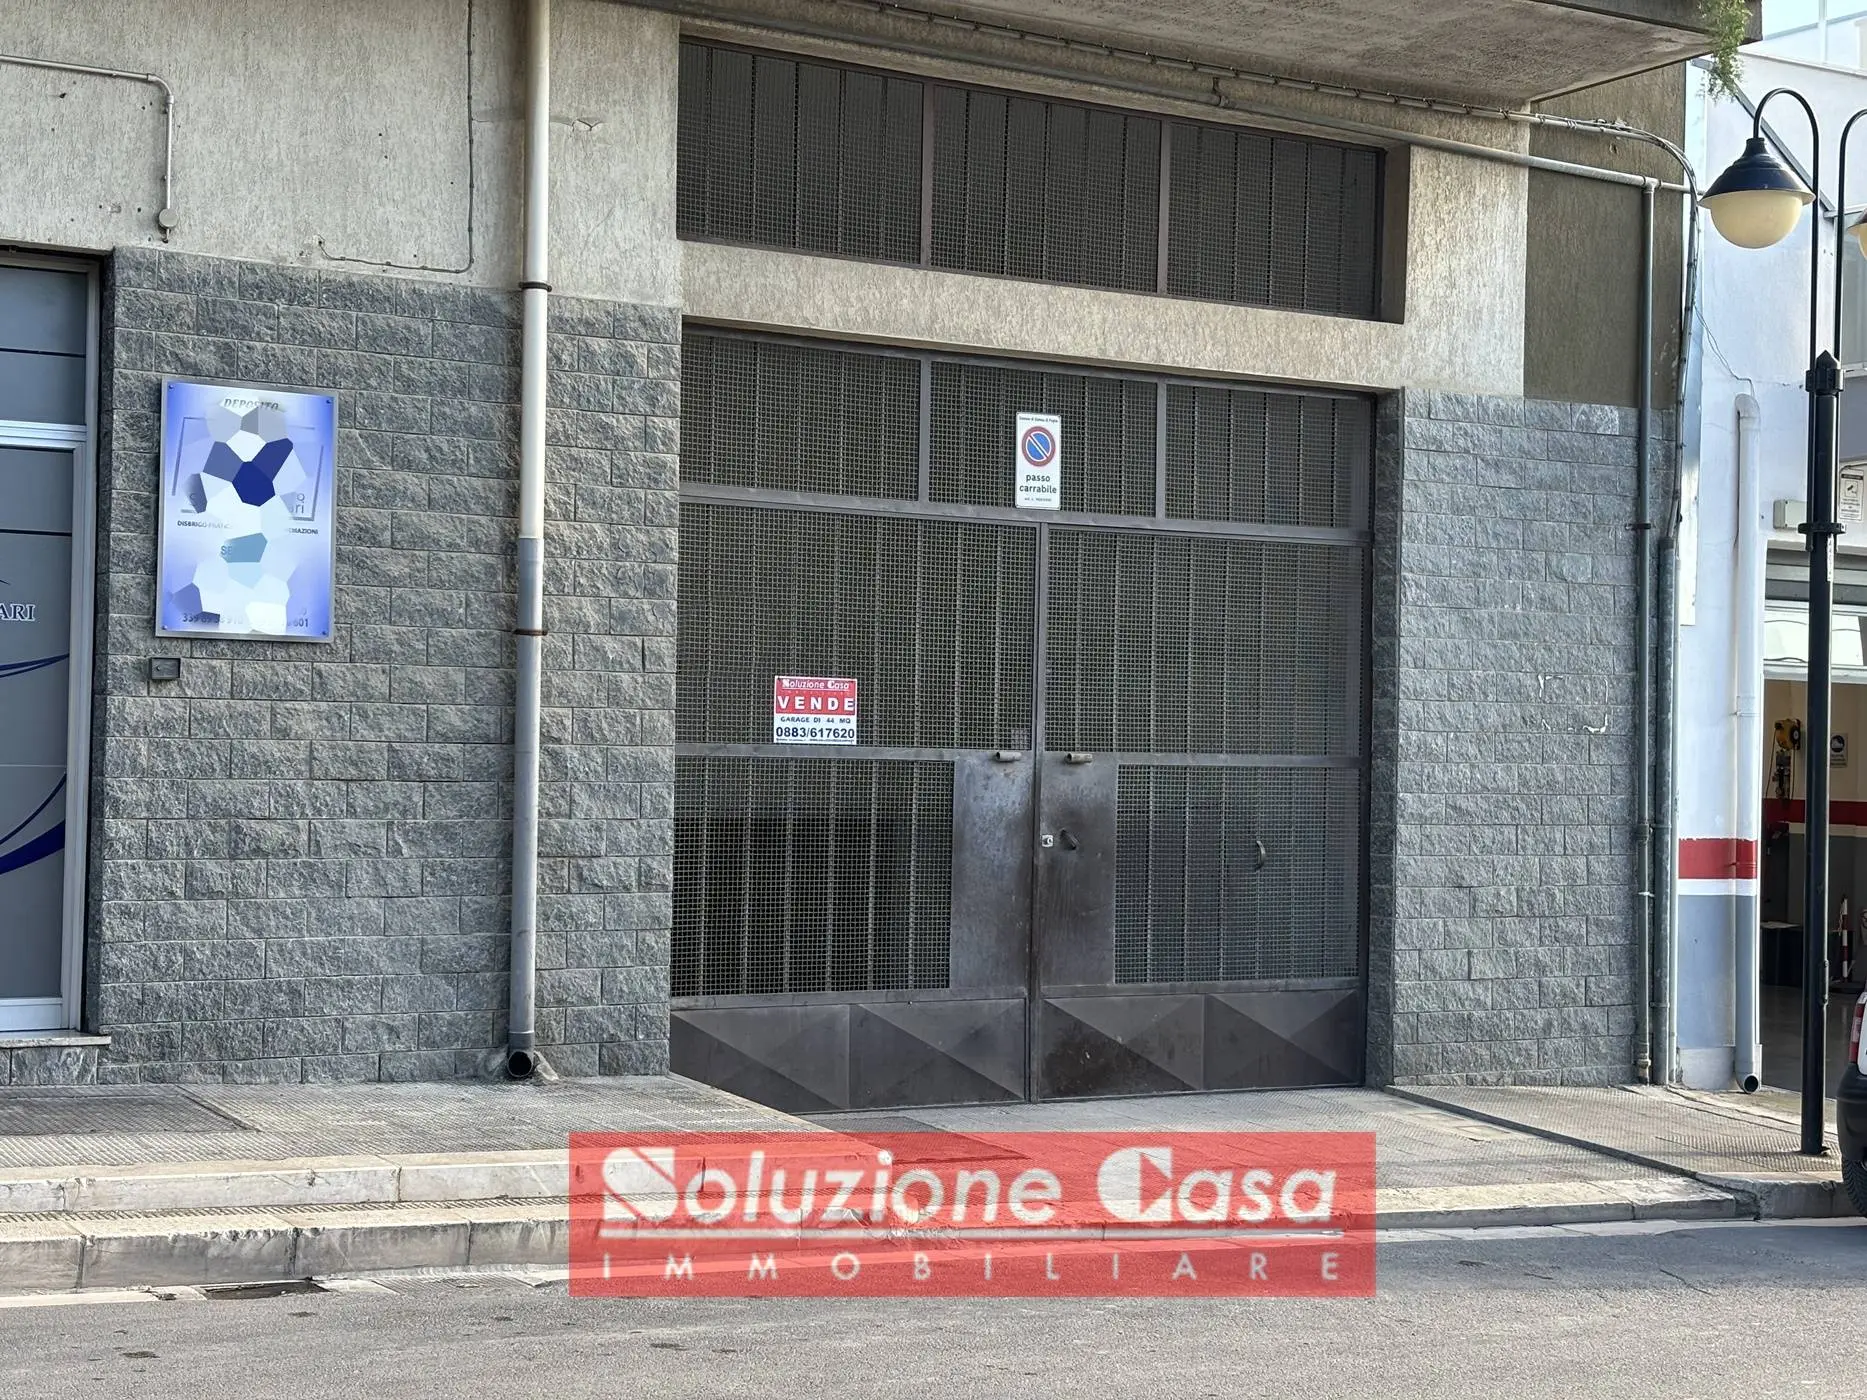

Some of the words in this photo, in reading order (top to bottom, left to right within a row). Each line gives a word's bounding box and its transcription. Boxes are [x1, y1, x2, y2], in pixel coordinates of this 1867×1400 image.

[1026, 474, 1050, 482] passo
[1019, 485, 1057, 493] carrabile
[782, 679, 825, 689] Soluzione
[827, 680, 849, 690] Casa
[777, 695, 855, 711] VENDE
[776, 726, 855, 739] 0883/617620
